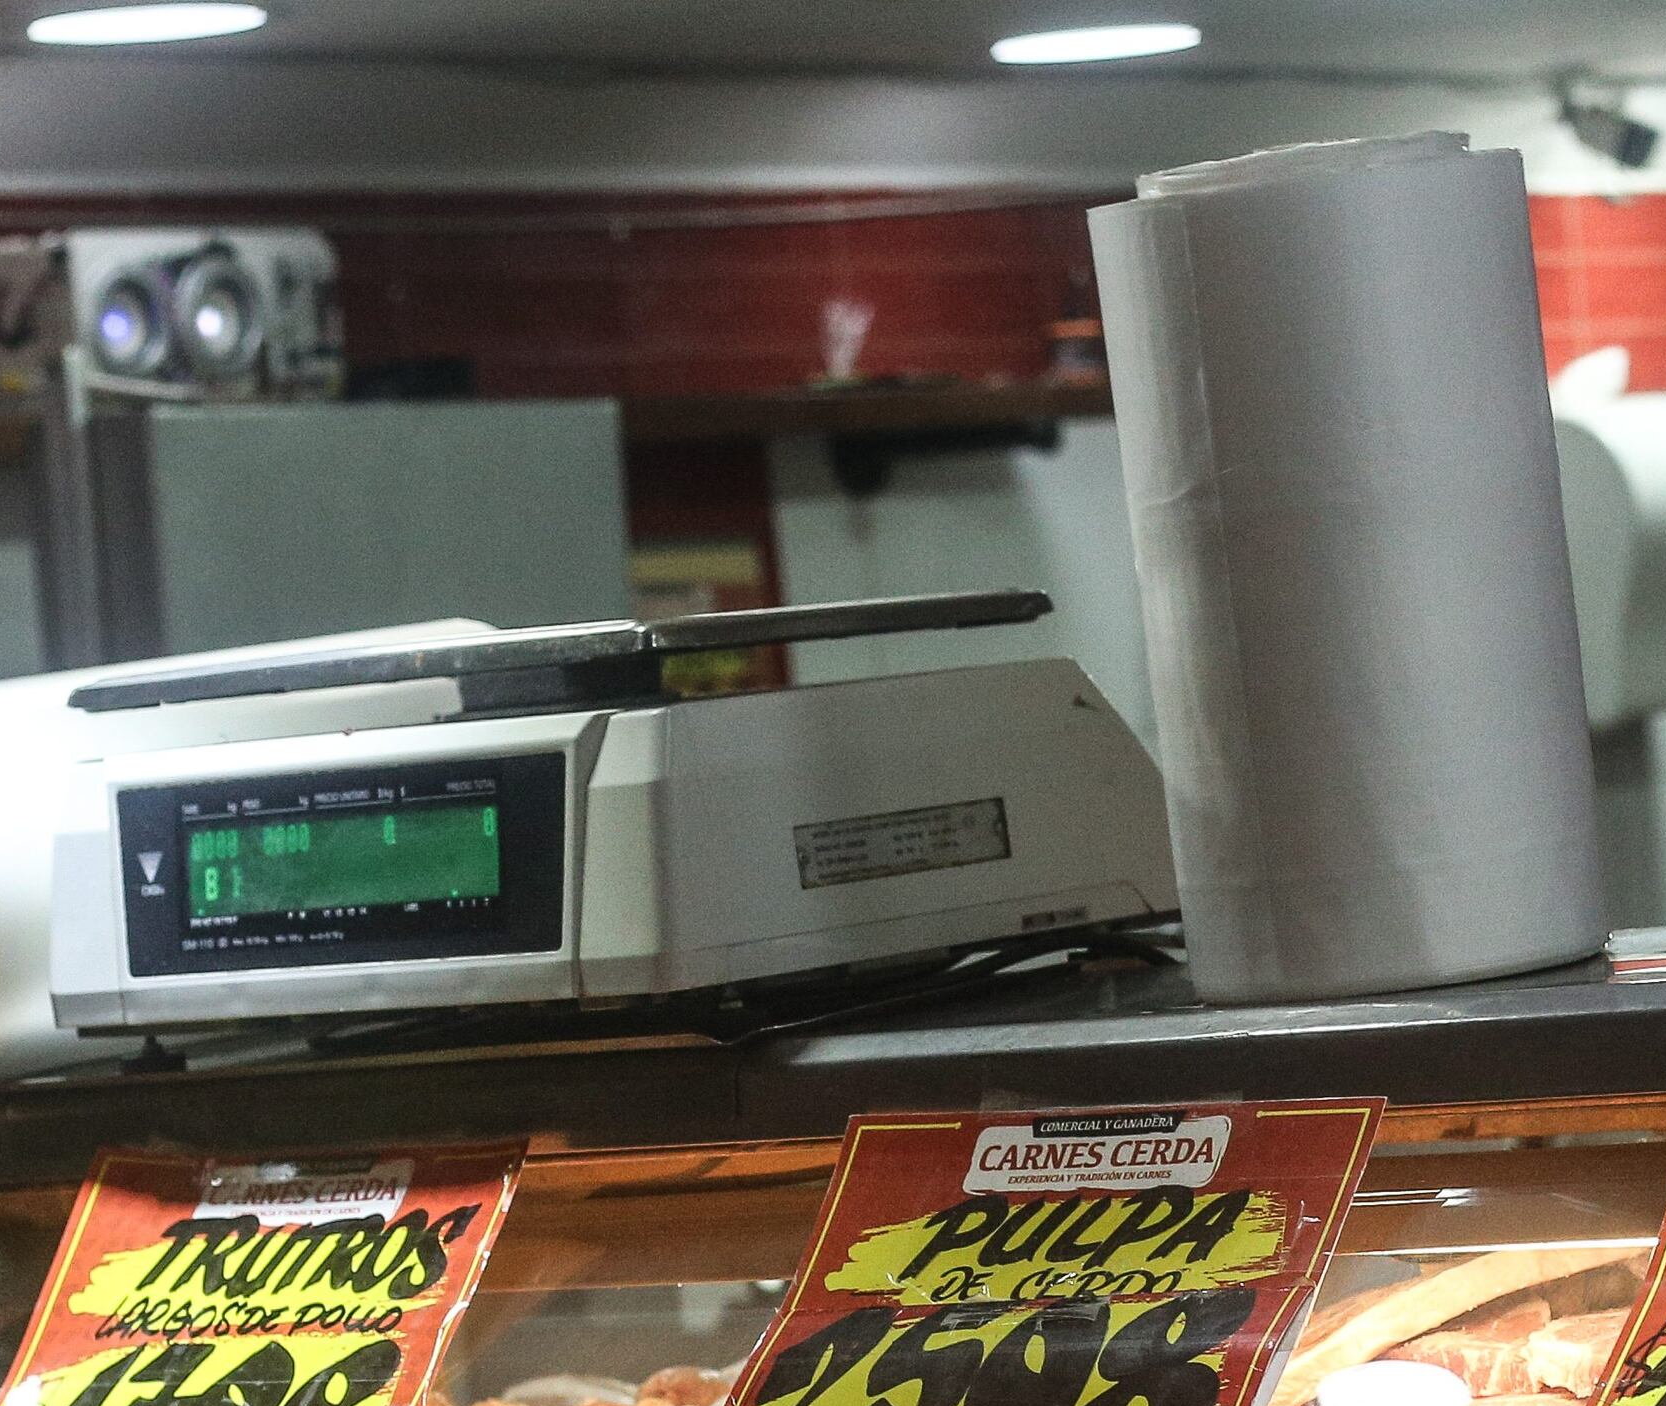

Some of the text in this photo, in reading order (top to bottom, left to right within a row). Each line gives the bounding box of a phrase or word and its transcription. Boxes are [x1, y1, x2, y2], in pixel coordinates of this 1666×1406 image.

[1039, 1121, 1104, 1134] COMERCIAL
[1104, 1120, 1113, 1130] Y
[978, 1136, 1214, 1172] CARNES CERDA
[315, 1176, 397, 1203] CERDA
[1007, 1170, 1173, 1185] EXPERIENCIA Y TRADICIÓN EN CARNES
[899, 1185, 1251, 1282] PULPA
[136, 1203, 483, 1300] TRUTROS
[930, 1266, 1184, 1301] DE CERDO
[95, 1296, 403, 1340] LARGOS DE POLLO
